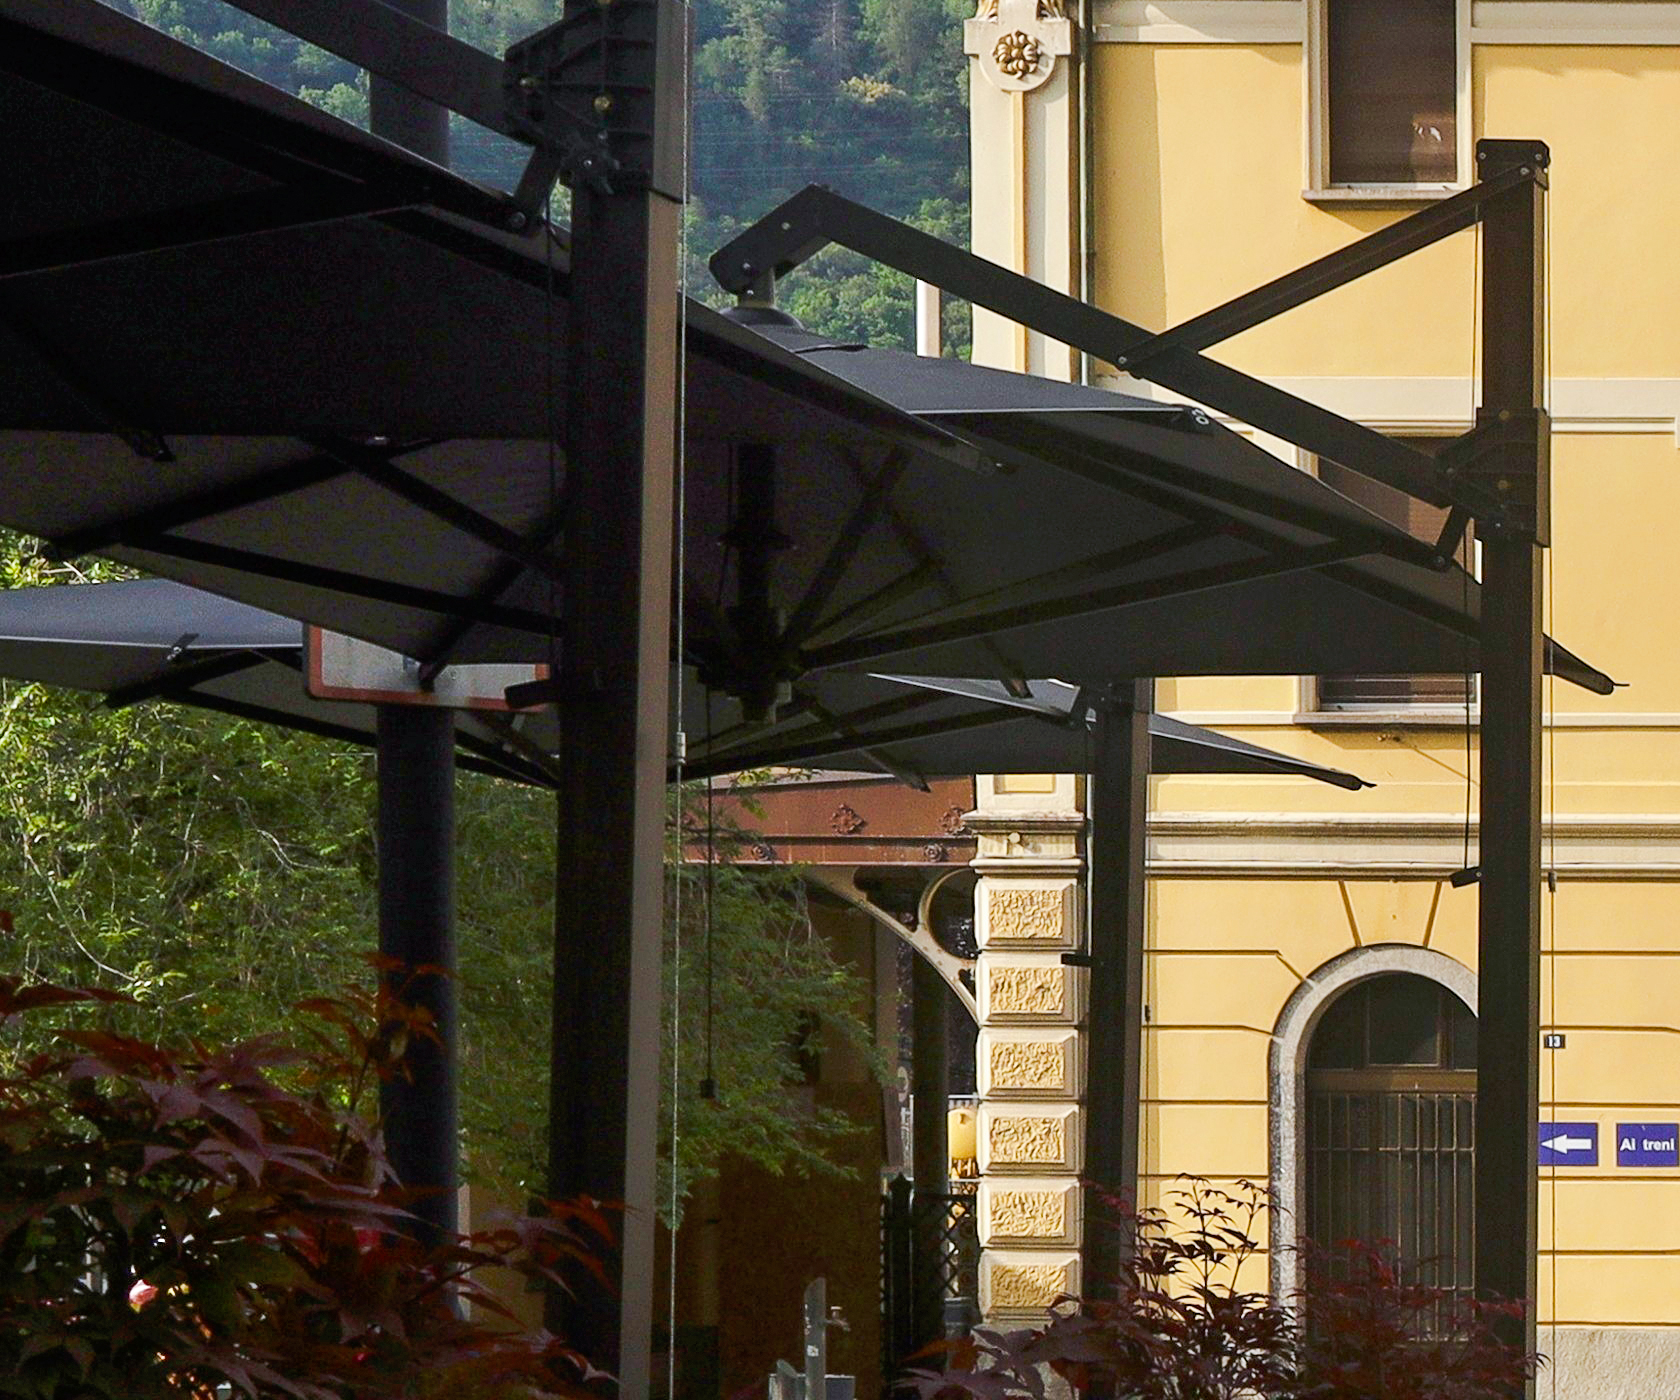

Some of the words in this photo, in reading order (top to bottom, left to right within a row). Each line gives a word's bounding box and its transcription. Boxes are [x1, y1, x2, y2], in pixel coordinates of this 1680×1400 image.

[1548, 1035, 1561, 1047] 13
[1620, 1138, 1636, 1151] Ai
[1642, 1138, 1675, 1151] treni
